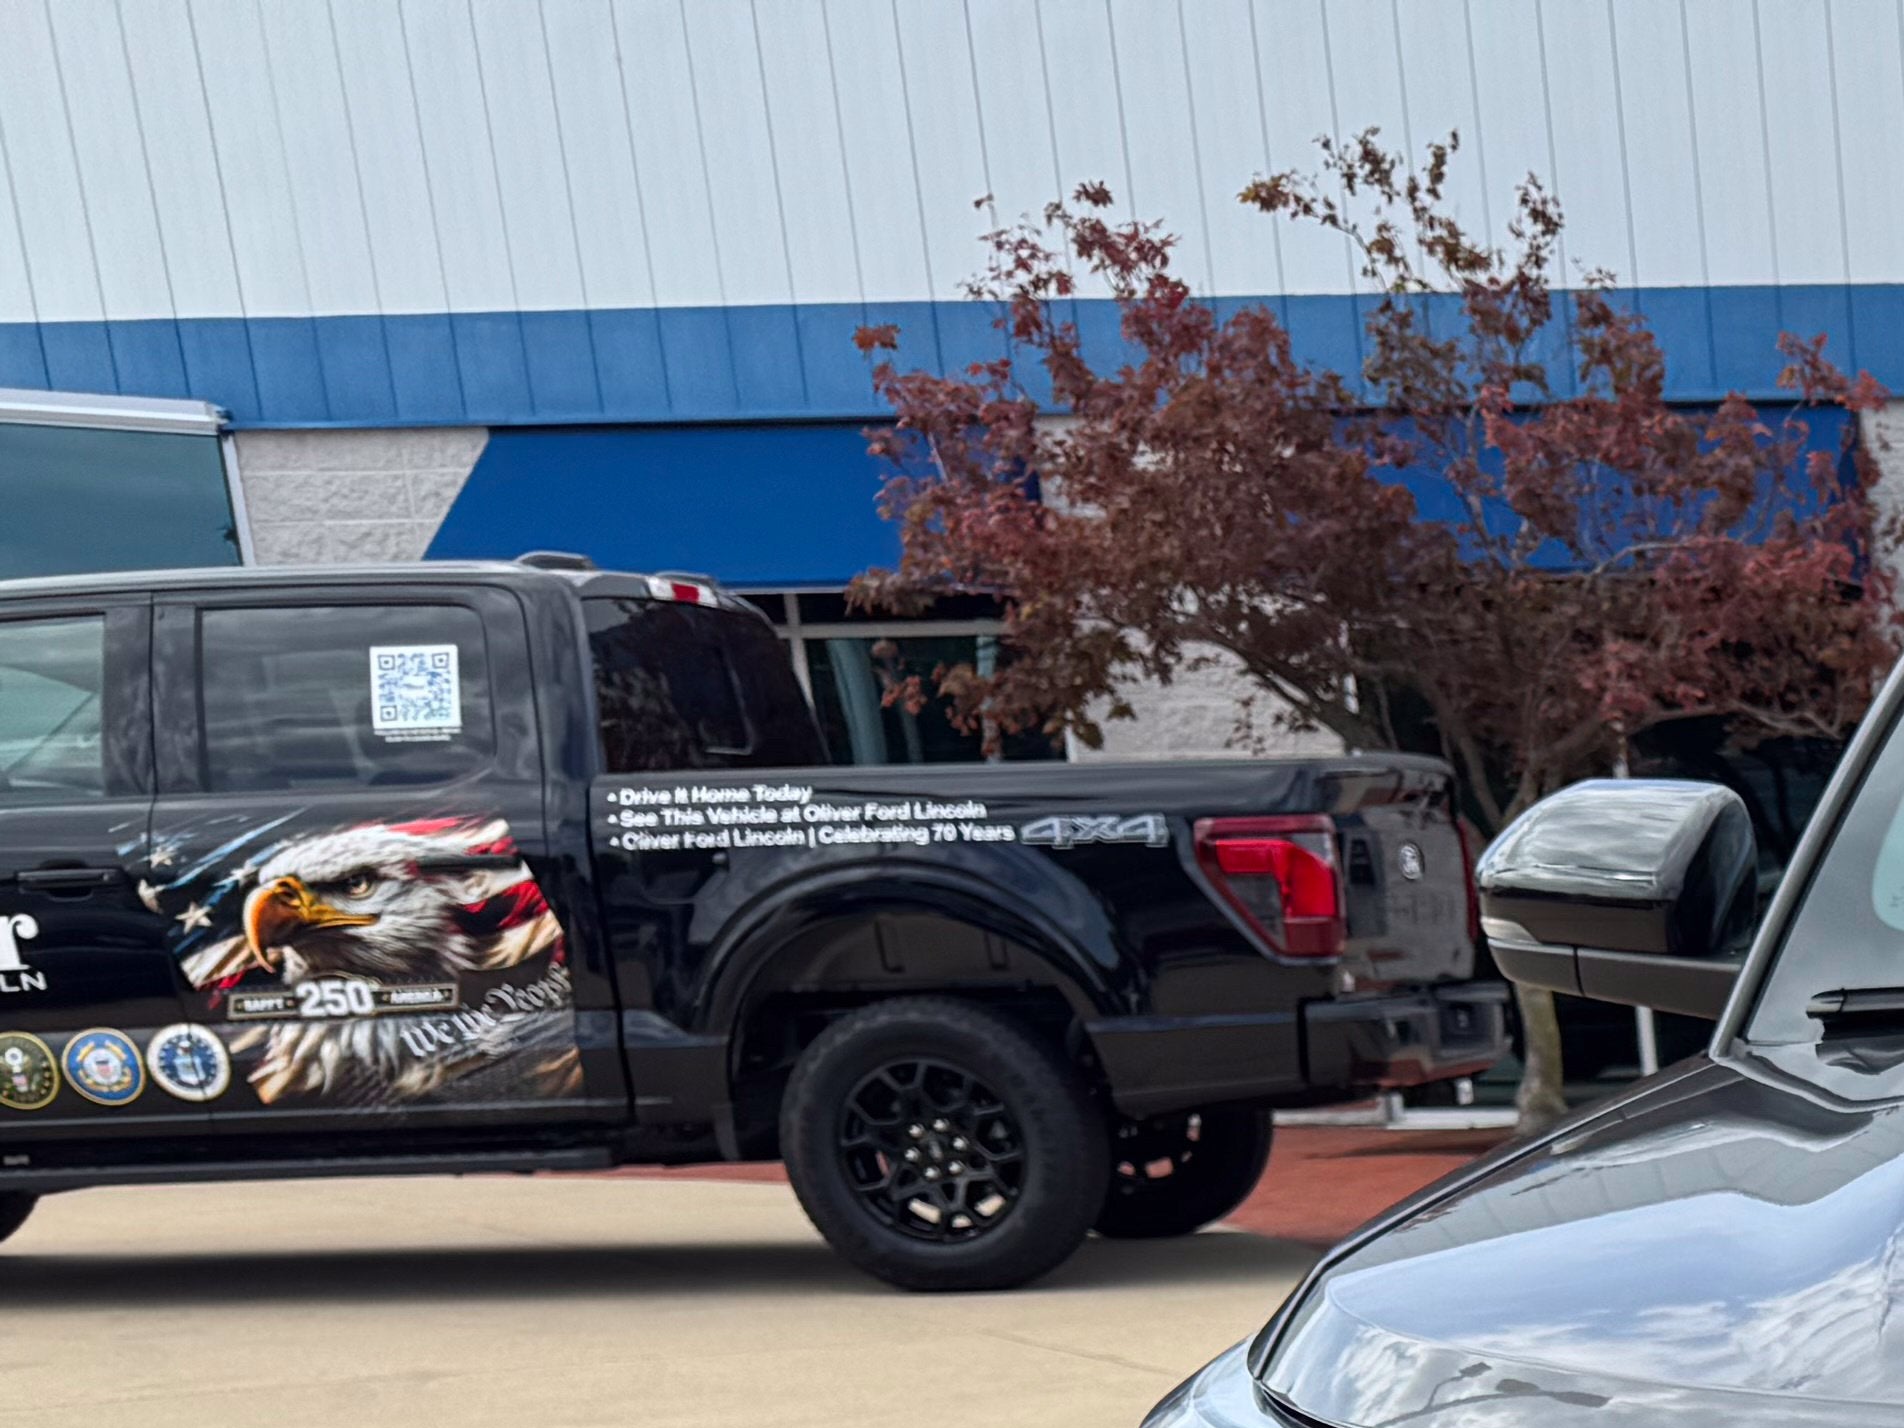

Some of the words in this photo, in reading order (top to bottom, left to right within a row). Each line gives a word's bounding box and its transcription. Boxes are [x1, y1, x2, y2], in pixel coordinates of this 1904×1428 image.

[620, 788, 671, 806] Drive
[692, 785, 750, 804] Home
[753, 784, 812, 805] Today
[620, 809, 659, 827] See
[661, 807, 705, 826] This
[707, 805, 778, 825] Vehicle
[780, 805, 800, 823] at
[804, 803, 862, 822] Oliver
[865, 801, 911, 821] Ford
[914, 800, 988, 820] Lincoln
[622, 829, 681, 850] Oliver
[684, 828, 731, 849] Ford
[733, 826, 806, 847] Lincoln
[818, 823, 930, 845] Celebrating
[932, 823, 957, 842] 70
[958, 822, 1016, 841] Years
[297, 980, 375, 1017] 250
